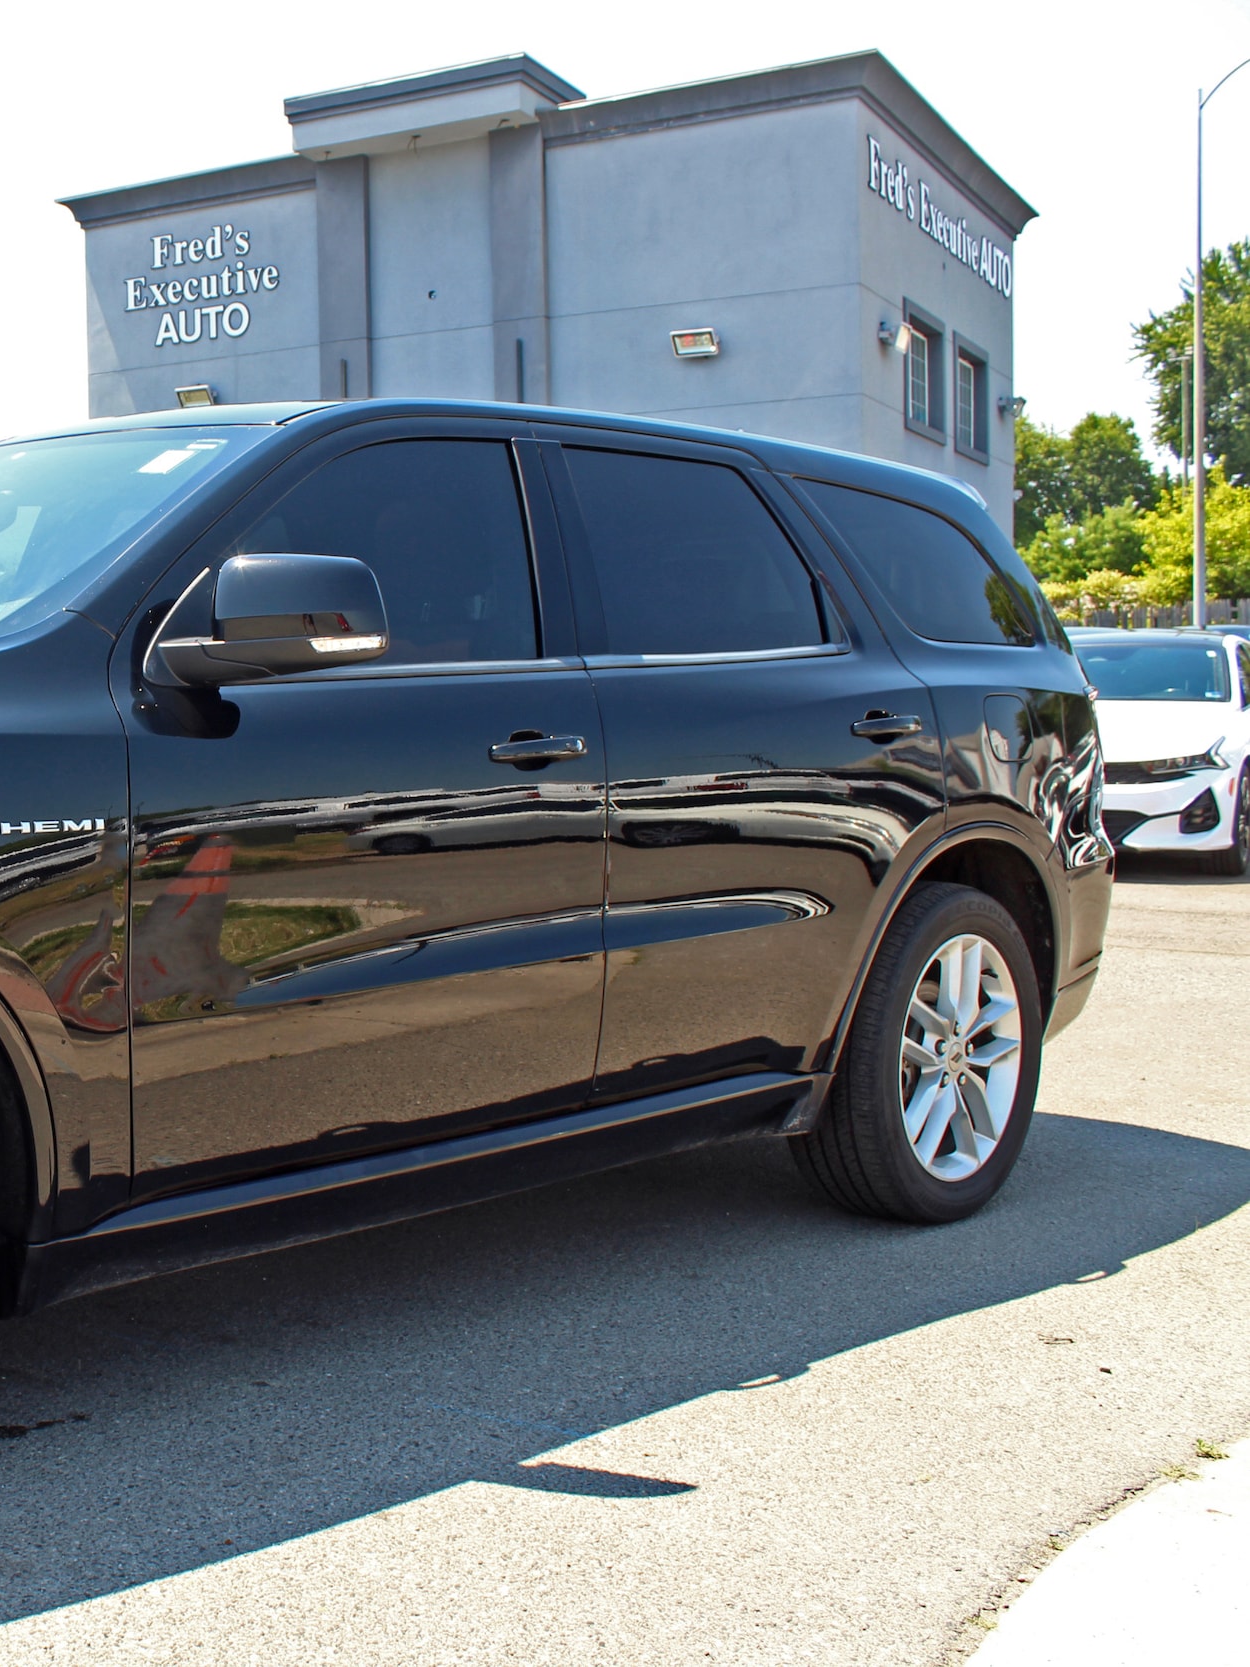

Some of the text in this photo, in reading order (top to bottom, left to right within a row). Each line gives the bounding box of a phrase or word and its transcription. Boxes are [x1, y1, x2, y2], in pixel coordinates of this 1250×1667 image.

[867, 134, 1012, 298] Fred's Executive AUTO
[151, 224, 251, 270] Fred's
[124, 261, 280, 313] Executive
[154, 301, 250, 347] AUTO
[0, 818, 106, 835] HEMI
